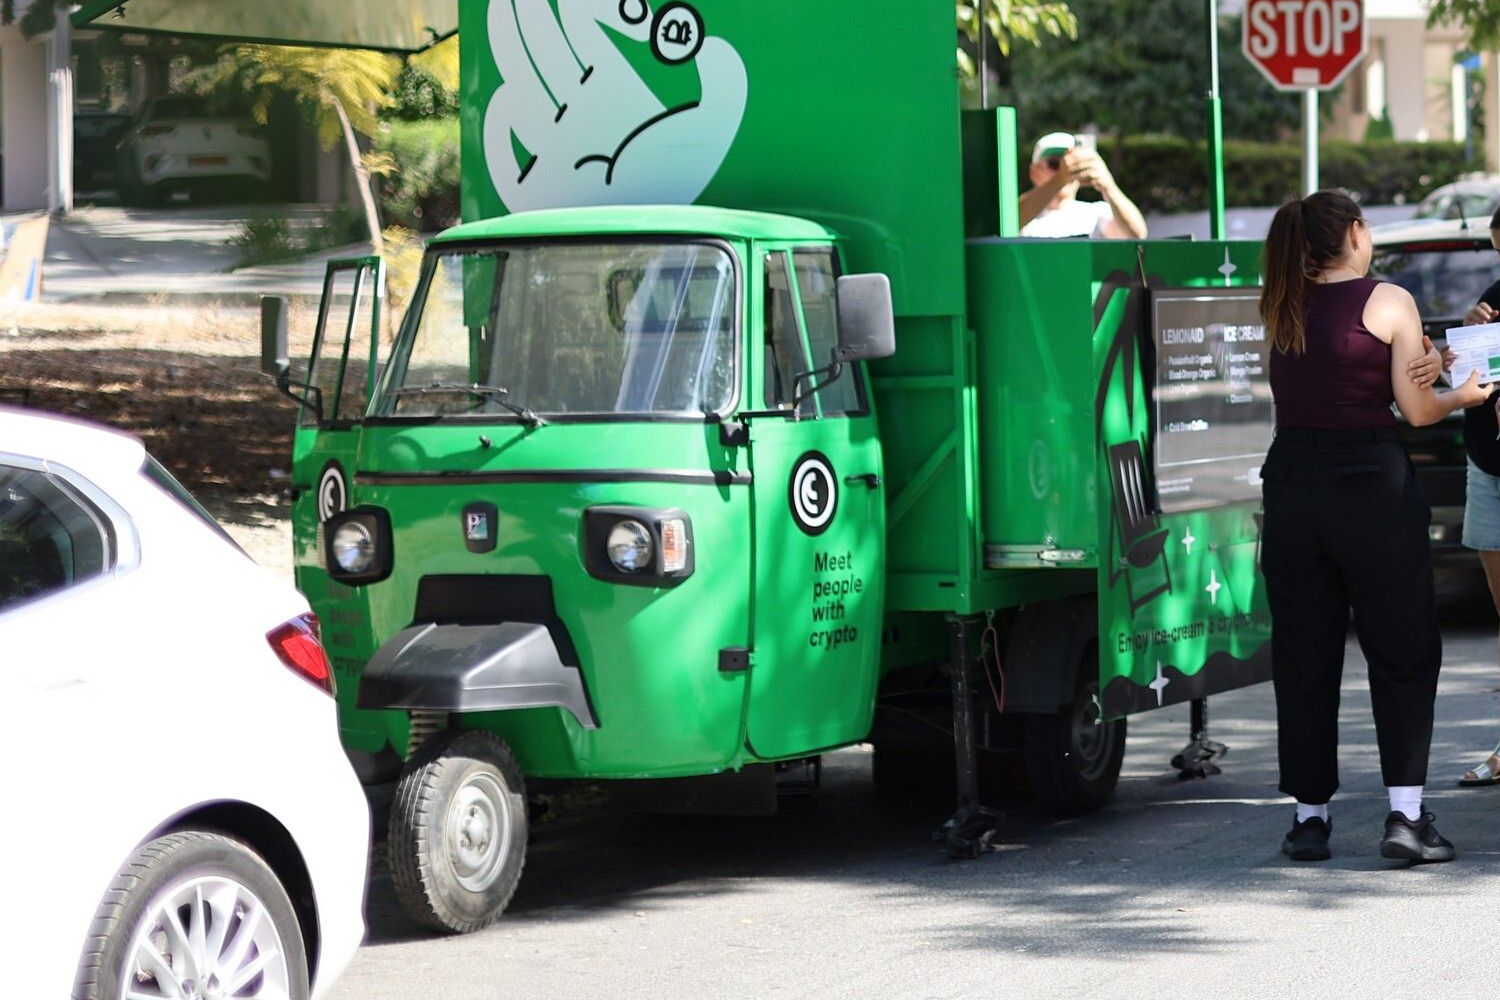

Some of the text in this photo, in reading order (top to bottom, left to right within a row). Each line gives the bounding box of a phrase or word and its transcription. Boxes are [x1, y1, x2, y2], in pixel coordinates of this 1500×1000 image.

[1163, 327, 1204, 345] LEMONAID
[1224, 325, 1265, 343] ICE CREAM
[814, 551, 852, 573] Meet
[813, 574, 863, 602] people
[811, 599, 845, 623] with
[809, 624, 858, 651] crypto
[1118, 631, 1148, 654] Enjoy
[1151, 621, 1204, 645] ice-cream
